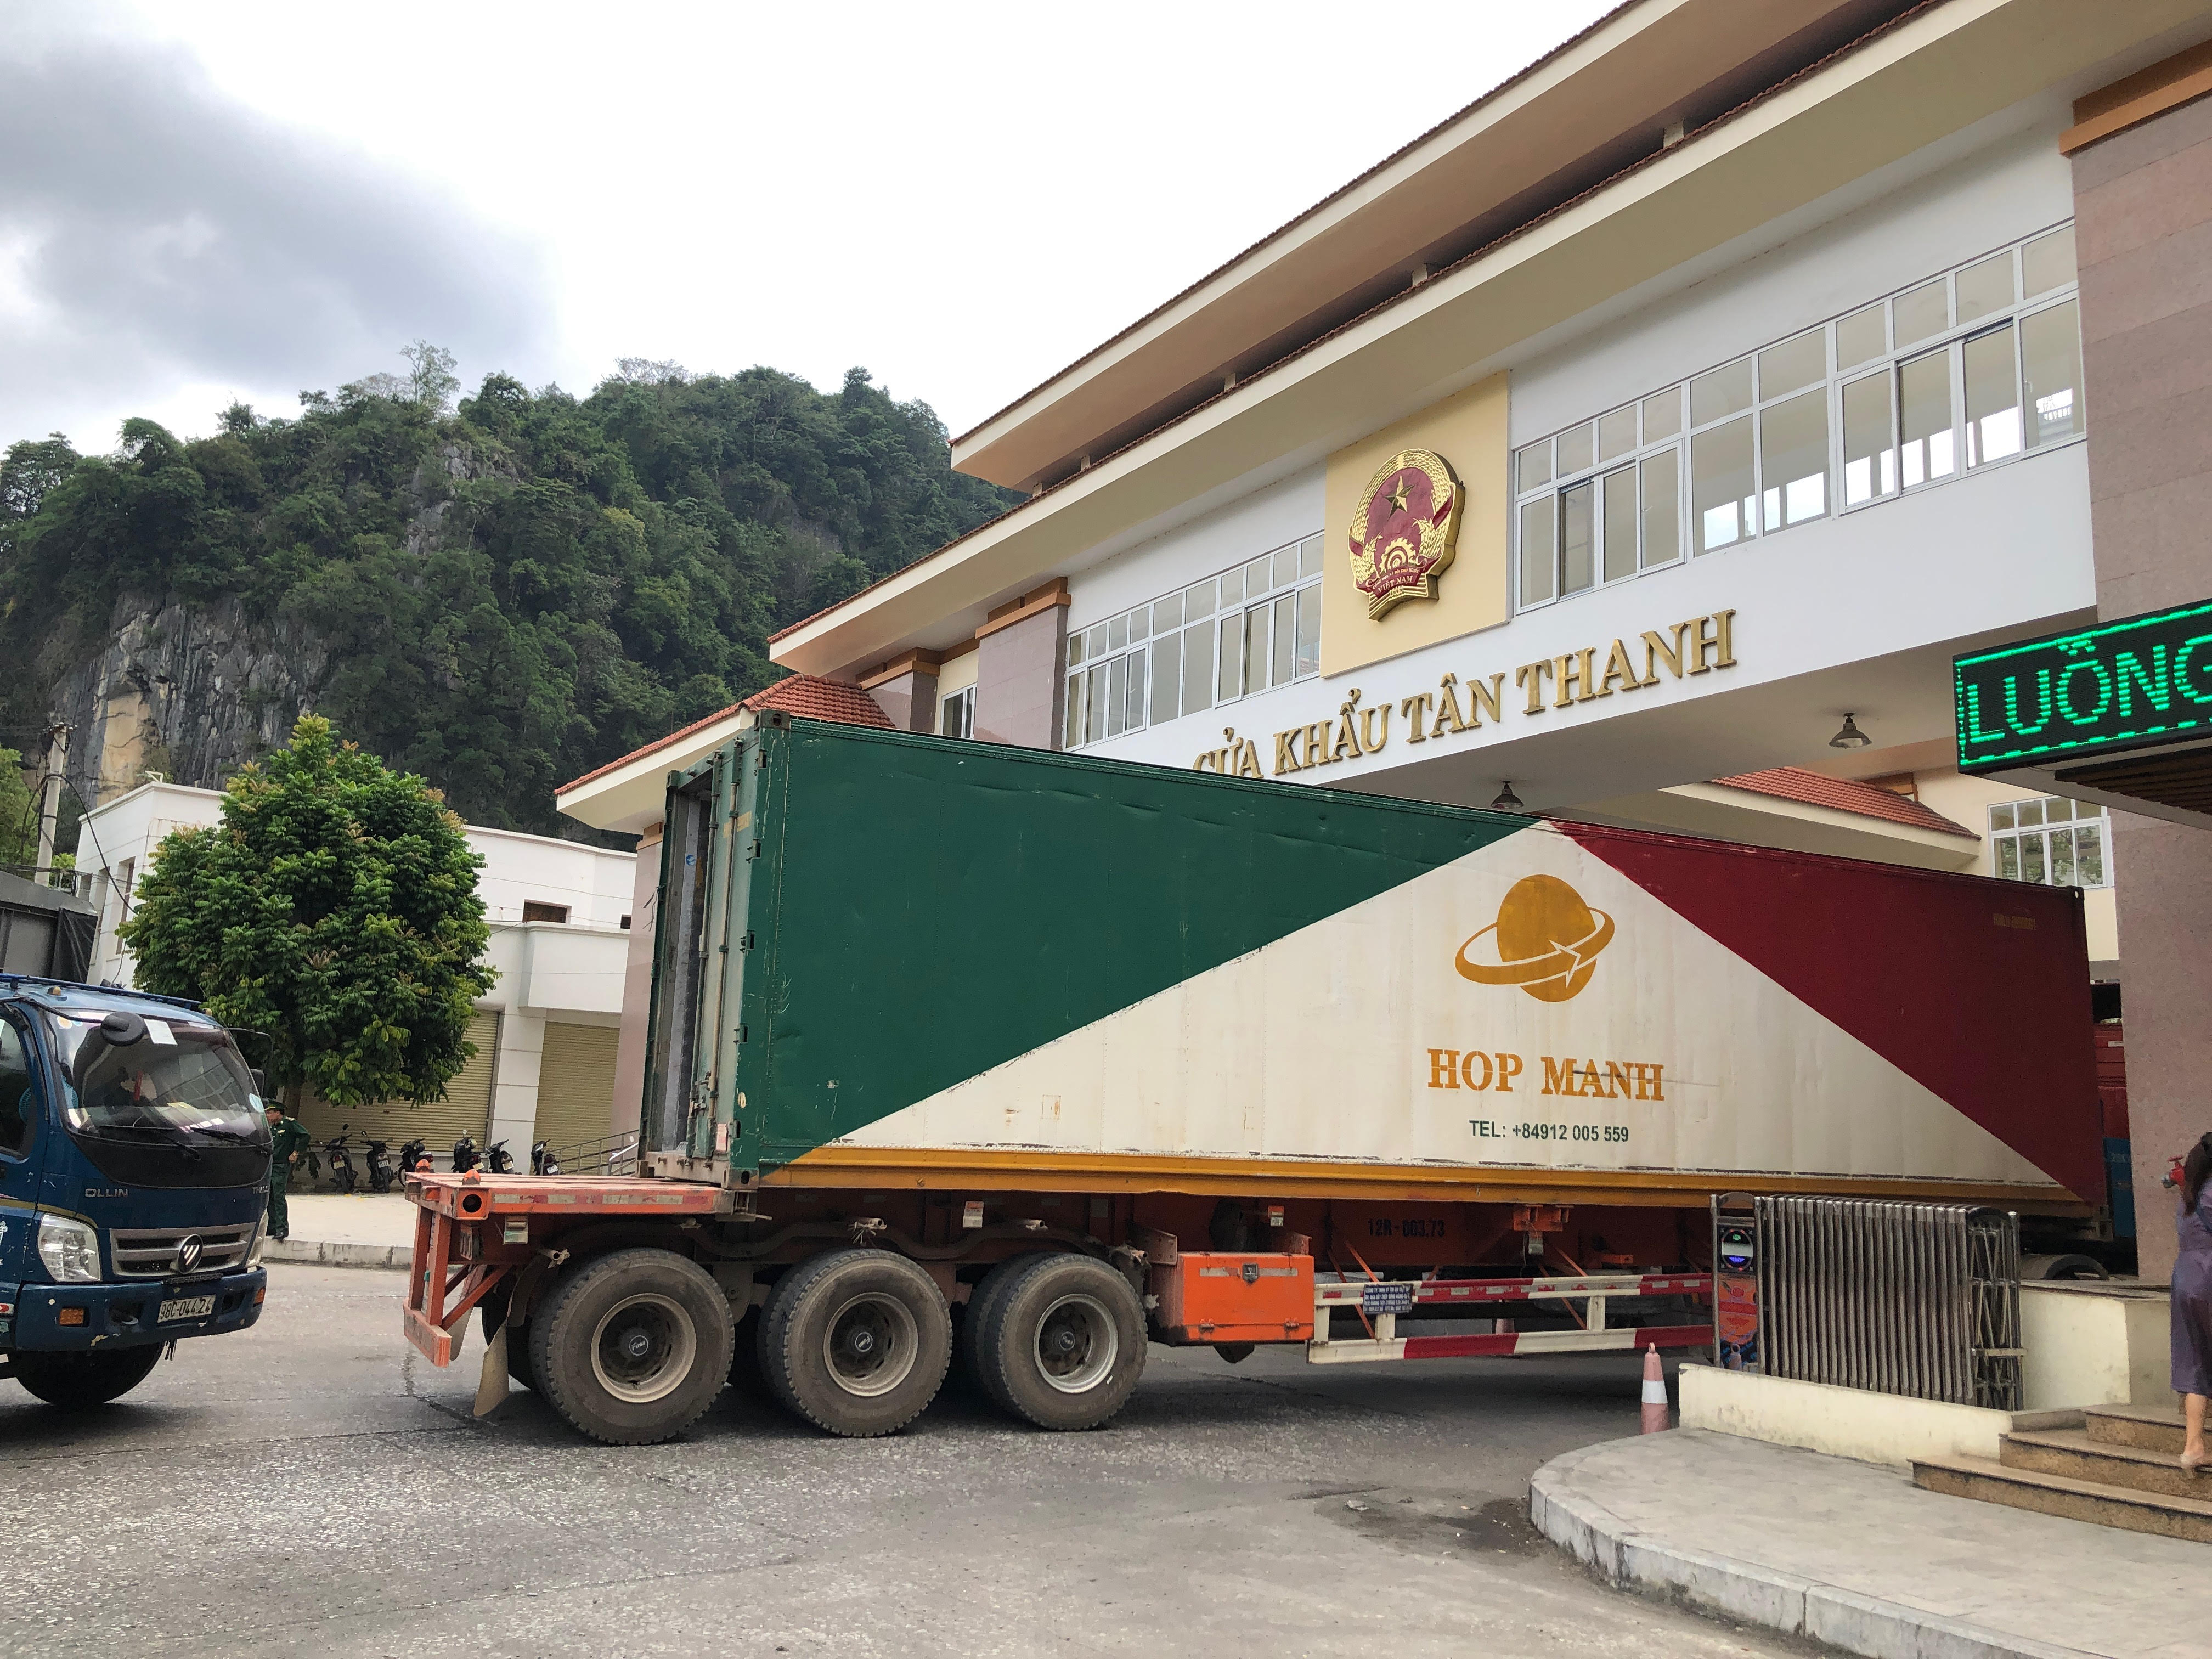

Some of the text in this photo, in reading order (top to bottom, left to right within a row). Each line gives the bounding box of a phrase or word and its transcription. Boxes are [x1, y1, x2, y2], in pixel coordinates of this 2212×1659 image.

[1378, 575, 1413, 592] VIỆT NAM
[1273, 688, 1392, 775] KHẨU
[1401, 672, 1505, 743] TÂN
[1516, 609, 1736, 714] THANH
[1427, 1048, 1664, 1101] HOP MANH
[1469, 1120, 1629, 1142] TEL: +84912 005 559
[85, 1188, 128, 1197] OLLIN
